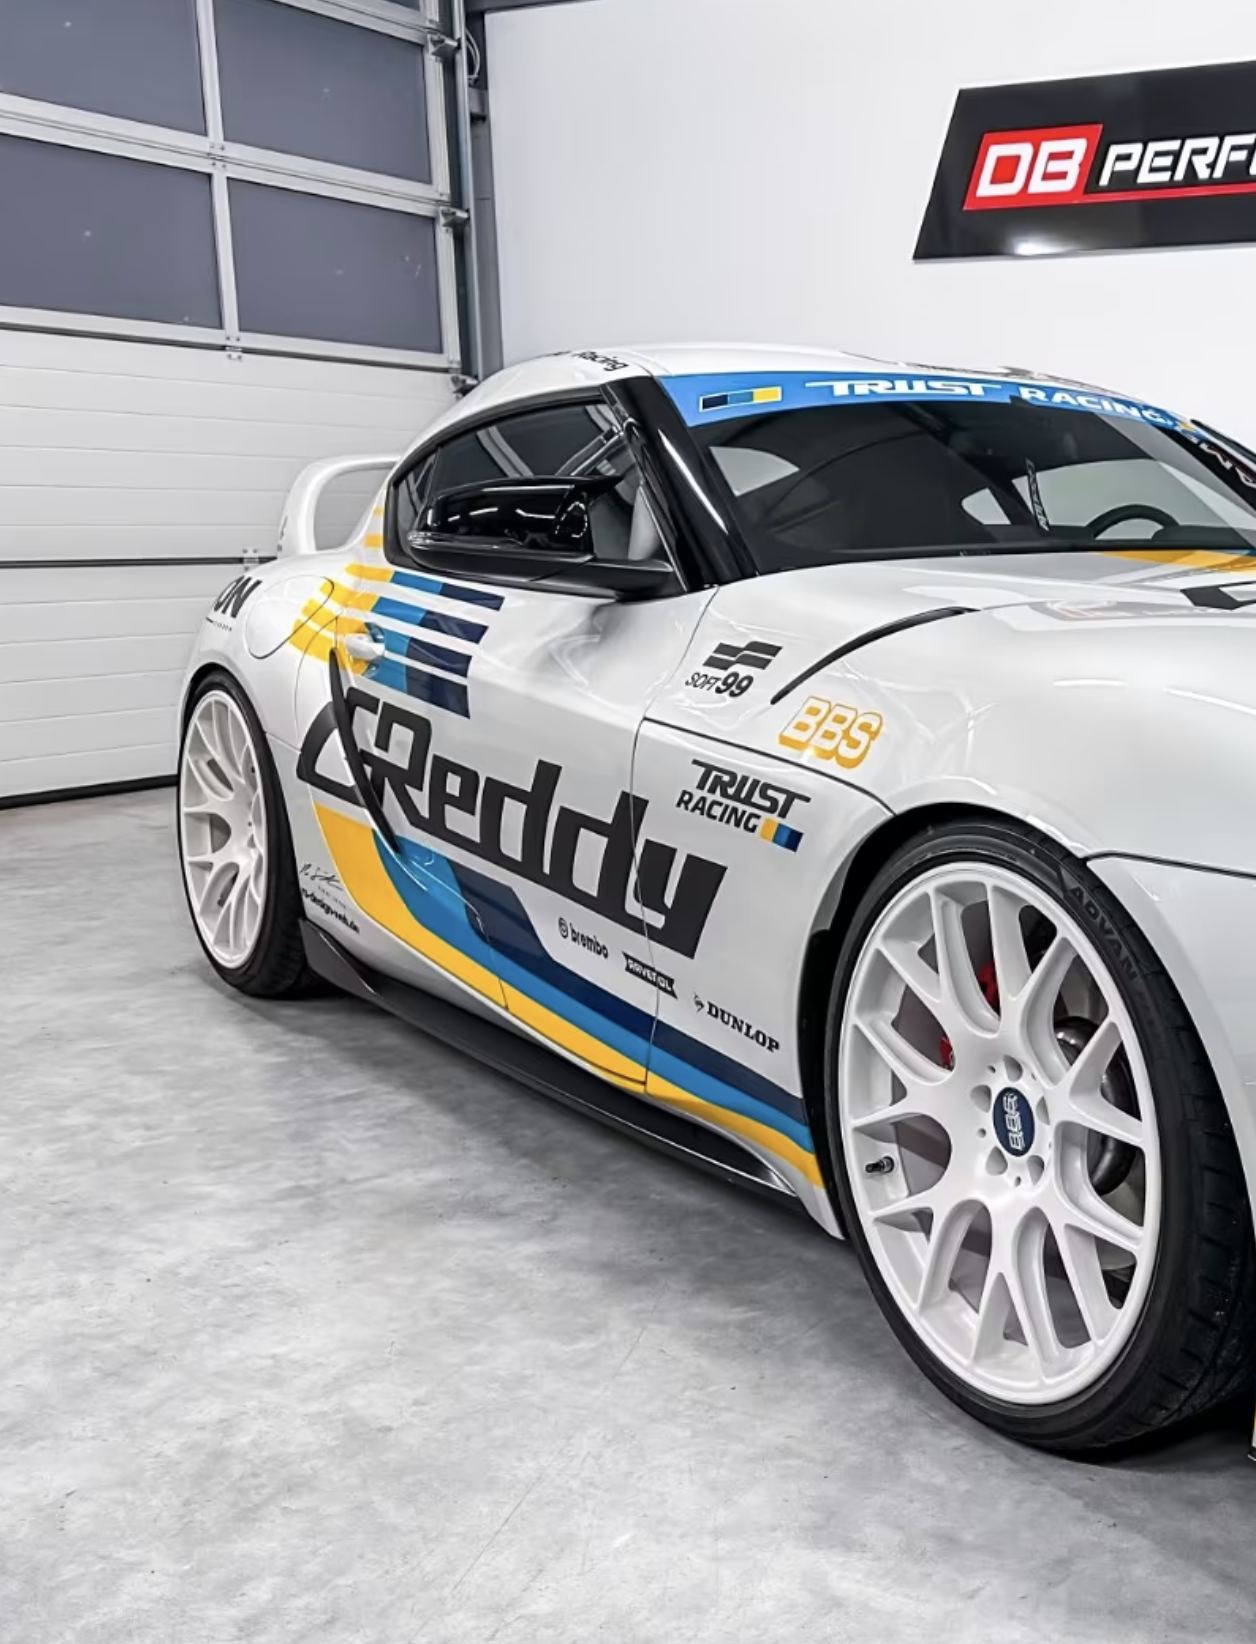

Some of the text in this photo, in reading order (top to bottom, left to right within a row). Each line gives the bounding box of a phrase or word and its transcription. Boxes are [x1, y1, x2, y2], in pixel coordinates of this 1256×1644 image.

[975, 138, 1085, 196] DB
[805, 379, 1168, 425] TRUST RACING
[778, 695, 884, 770] BBS
[675, 789, 762, 833] RACING
[691, 758, 812, 819] TRUST
[295, 686, 728, 960] GReddy
[570, 922, 609, 959] brembo
[1069, 885, 1139, 982] ADVAN
[706, 1000, 781, 1054] DUNLOP
[1003, 1091, 1026, 1152] BBS
